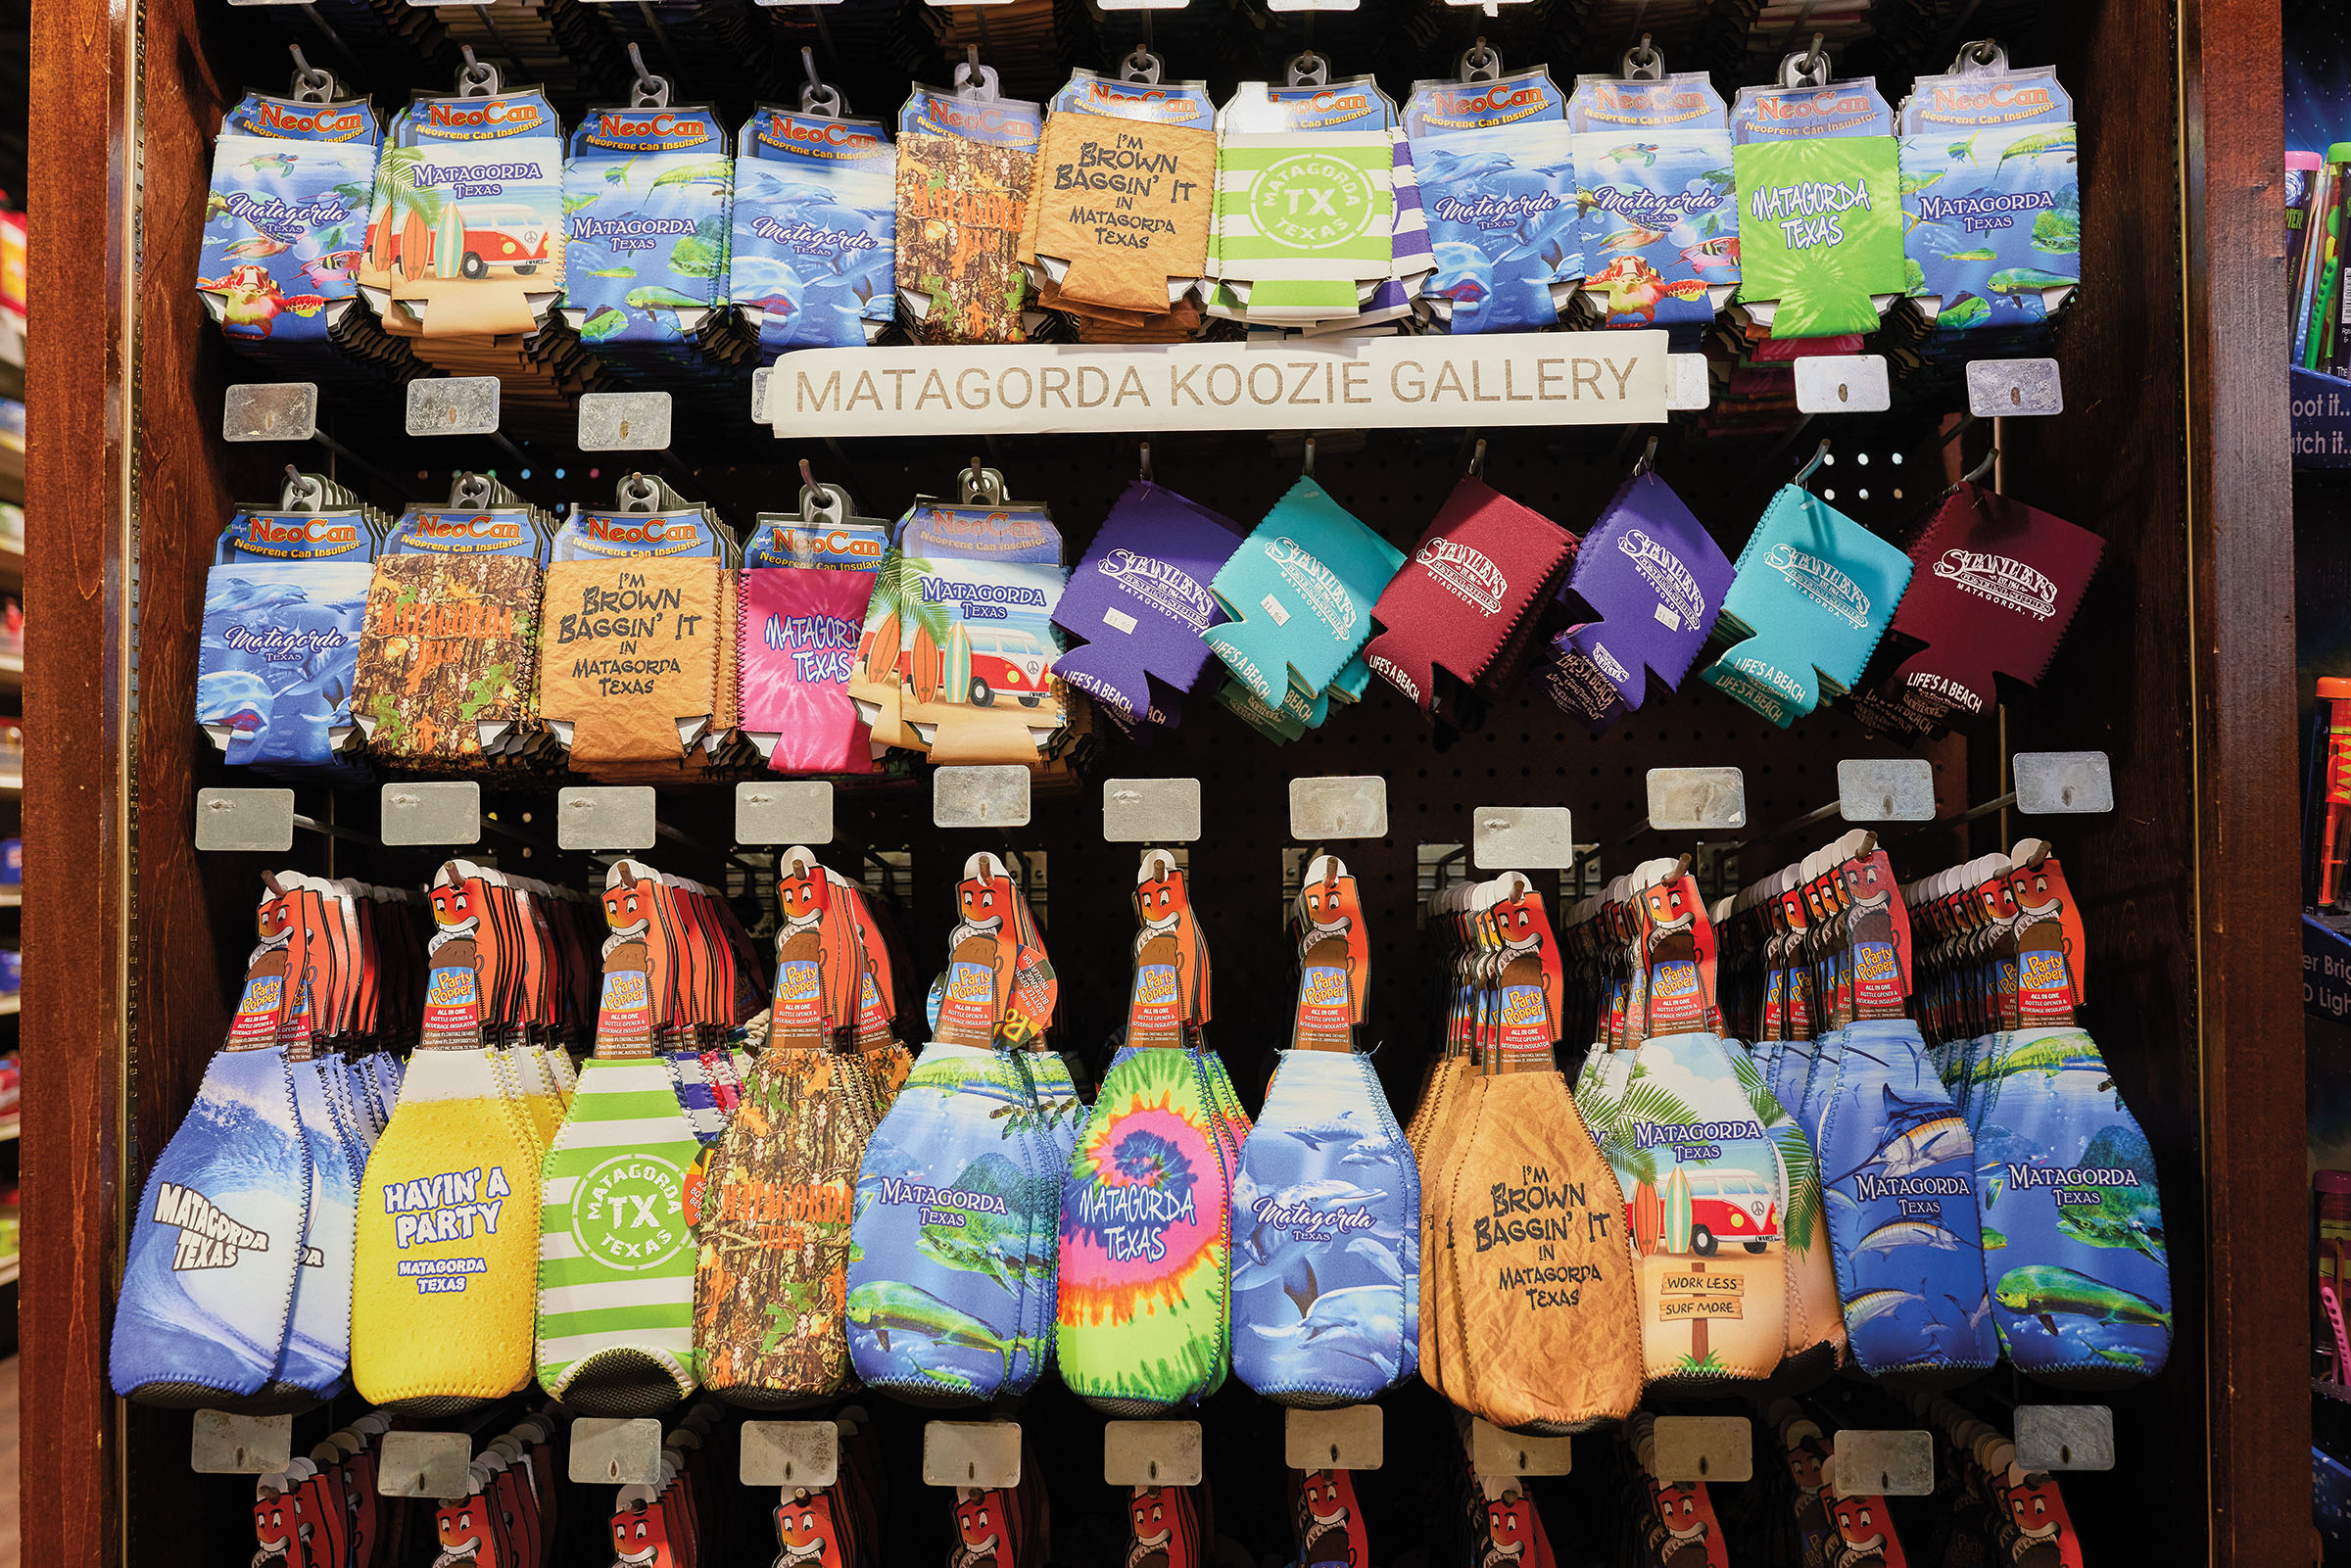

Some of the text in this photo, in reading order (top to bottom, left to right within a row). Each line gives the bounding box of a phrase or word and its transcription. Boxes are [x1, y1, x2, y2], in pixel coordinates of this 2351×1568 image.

[1433, 84, 1545, 117] NeoCan
[1596, 85, 1706, 111] NeoCan
[1756, 91, 1872, 121] NeoCan
[1934, 84, 2050, 112] NeoCan
[258, 102, 362, 133] NeoCan
[429, 101, 539, 126] NeoCan
[599, 113, 706, 138] NeoCan
[930, 98, 1034, 139] NeoCan
[1421, 99, 1550, 128] Neoprene Can Insulator
[415, 118, 544, 140] Neoprene Can Insulator
[771, 115, 878, 148] NeoCan
[1116, 133, 1143, 150] I'M
[1079, 141, 1177, 174] BROWN
[412, 162, 543, 188] MATAGORDA
[1054, 163, 1197, 204] BAGGIN' IT
[1262, 163, 1361, 208] MATAGORDA
[454, 183, 502, 199] TEXAS
[1115, 197, 1133, 211] IN
[1283, 187, 1336, 216] TX
[1593, 185, 1724, 215] Matagorda
[1751, 178, 1872, 222] MATAGORDA
[225, 193, 350, 228] Matagorda
[1434, 190, 1560, 224] Matagorda
[1638, 213, 1678, 223] TEXAS
[1919, 191, 2054, 220] MATAGORDA
[264, 222, 305, 234] TEXAS
[572, 216, 696, 240] MATAGORDA
[751, 215, 878, 252] Matagorda
[1069, 205, 1176, 235] MATAGORDA
[1275, 217, 1349, 240] TEXAS
[1477, 219, 1516, 231] TEXAS
[1780, 214, 1845, 250] TEXAS
[1963, 216, 2014, 233] TEXAS
[609, 237, 655, 252] TEXAS
[793, 244, 832, 257] TEXAS
[1095, 226, 1149, 249] TEXAS
[793, 356, 1639, 413] MATAGORDA KOOZIE GALLERY
[249, 517, 358, 544] NeoCan
[414, 514, 520, 539] NeoCan
[587, 518, 697, 544] NeoCan
[932, 510, 1042, 538] NeoCan
[233, 539, 360, 558] Neoprene Can Insulator
[618, 572, 646, 590] I'M
[1097, 547, 1214, 617] STANLEY'S
[1415, 537, 1508, 599] STANLEY'S
[1617, 529, 1705, 618] STANLEY'S
[1763, 543, 1871, 616] STANLEY'S
[1933, 548, 2058, 603] STANLEY'S
[920, 577, 1046, 607] MATAGORDA
[1265, 536, 1357, 629] STANLEY'S
[581, 586, 681, 616] BROWN
[961, 602, 1007, 620] TEXAS
[1478, 606, 1491, 618] TX
[377, 602, 512, 640] MATAGORDA
[557, 612, 702, 644] BAGGIN' IT
[765, 612, 862, 650] MATAGORD
[1186, 622, 1200, 634] TX
[1684, 621, 1693, 633] TX
[1848, 620, 1859, 632] TX
[2032, 611, 2045, 623] TX
[223, 625, 349, 654] Matagorda
[619, 641, 637, 655] IN
[1331, 630, 1341, 642] TX
[265, 652, 302, 662] TEXAS
[571, 658, 681, 679] MATAGORDA
[792, 650, 852, 684] TEXAS
[1210, 639, 1271, 699] LIFE'S A BEACH
[599, 677, 654, 697] TEXAS
[1063, 670, 1133, 714] LIFE'S A BEACH
[1368, 655, 1420, 704] LIFE'S A BEACH
[1734, 657, 1806, 704] LIFE'S A BEACH
[1906, 672, 1942, 690] LIFE'S
[1939, 679, 1950, 694] A
[1948, 682, 1983, 714] BEACH
[1861, 946, 1893, 966] Party
[2028, 955, 2063, 974] Party
[437, 972, 472, 990] Party
[610, 974, 645, 995] Party
[958, 967, 991, 986] Party
[1023, 954, 1050, 991] INSULATOR
[242, 990, 279, 1014] Popper
[252, 980, 281, 999] Party
[429, 984, 474, 1006] Popper
[603, 988, 646, 1012] Popper
[1509, 990, 1542, 1011] Party
[1633, 1120, 1762, 1149] MATAGORDA
[1673, 1145, 1722, 1164] TEXAS
[1522, 1164, 1550, 1186] I'M
[1854, 1173, 1971, 1202] MATAGORDA
[2008, 1163, 2139, 1189] MATAGORDA
[383, 1166, 510, 1213] HAVIN' A
[587, 1164, 683, 1220] MATAGORDA
[720, 1182, 853, 1225] MATAGORDA
[880, 1176, 1008, 1215] MATAGORDA
[1491, 1182, 1586, 1218] BROWN
[2052, 1188, 2101, 1207] TEXAS
[153, 1181, 269, 1252] MATAGORDA
[607, 1194, 661, 1229] TX
[918, 1207, 967, 1228] TEXAS
[1079, 1183, 1197, 1226] MATAGORDA
[1251, 1196, 1377, 1235] Matagorda
[1897, 1199, 1942, 1216] TEXAS
[396, 1199, 503, 1250] PARTY
[1292, 1229, 1332, 1242] TEXAS
[1473, 1211, 1610, 1253] BAGGIN' IT
[172, 1227, 239, 1272] TEXAS
[600, 1229, 673, 1258] TEXAS
[1103, 1224, 1167, 1263] TEXAS
[1538, 1244, 1555, 1261] IN
[398, 1258, 487, 1276] MATAGORDA
[1499, 1263, 1603, 1291] MATAGORDA
[416, 1276, 466, 1294] TEXAS
[1667, 1276, 1737, 1290] WORK LESS
[1525, 1288, 1580, 1310] TEXAS
[1665, 1302, 1735, 1314] SURF MORE
